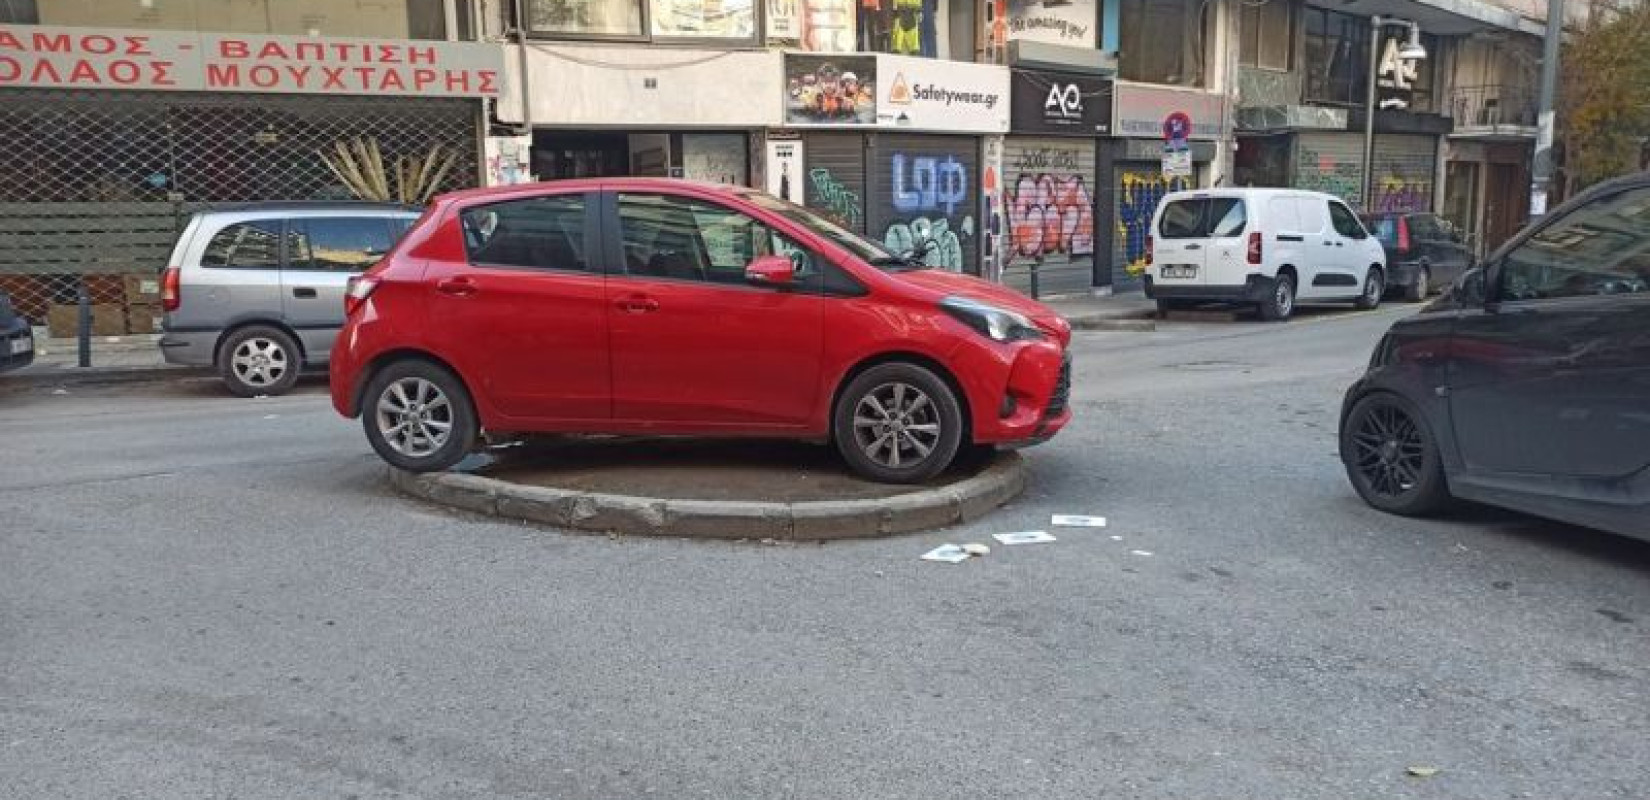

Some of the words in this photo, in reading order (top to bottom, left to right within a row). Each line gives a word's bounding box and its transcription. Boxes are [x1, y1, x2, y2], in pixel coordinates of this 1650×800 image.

[220, 40, 436, 64] ΒΑΠΤΙΣΗ
[207, 63, 499, 93] ΜΟΥΧΤΑΡΗΣ
[913, 83, 998, 109] Safetywear.gr
